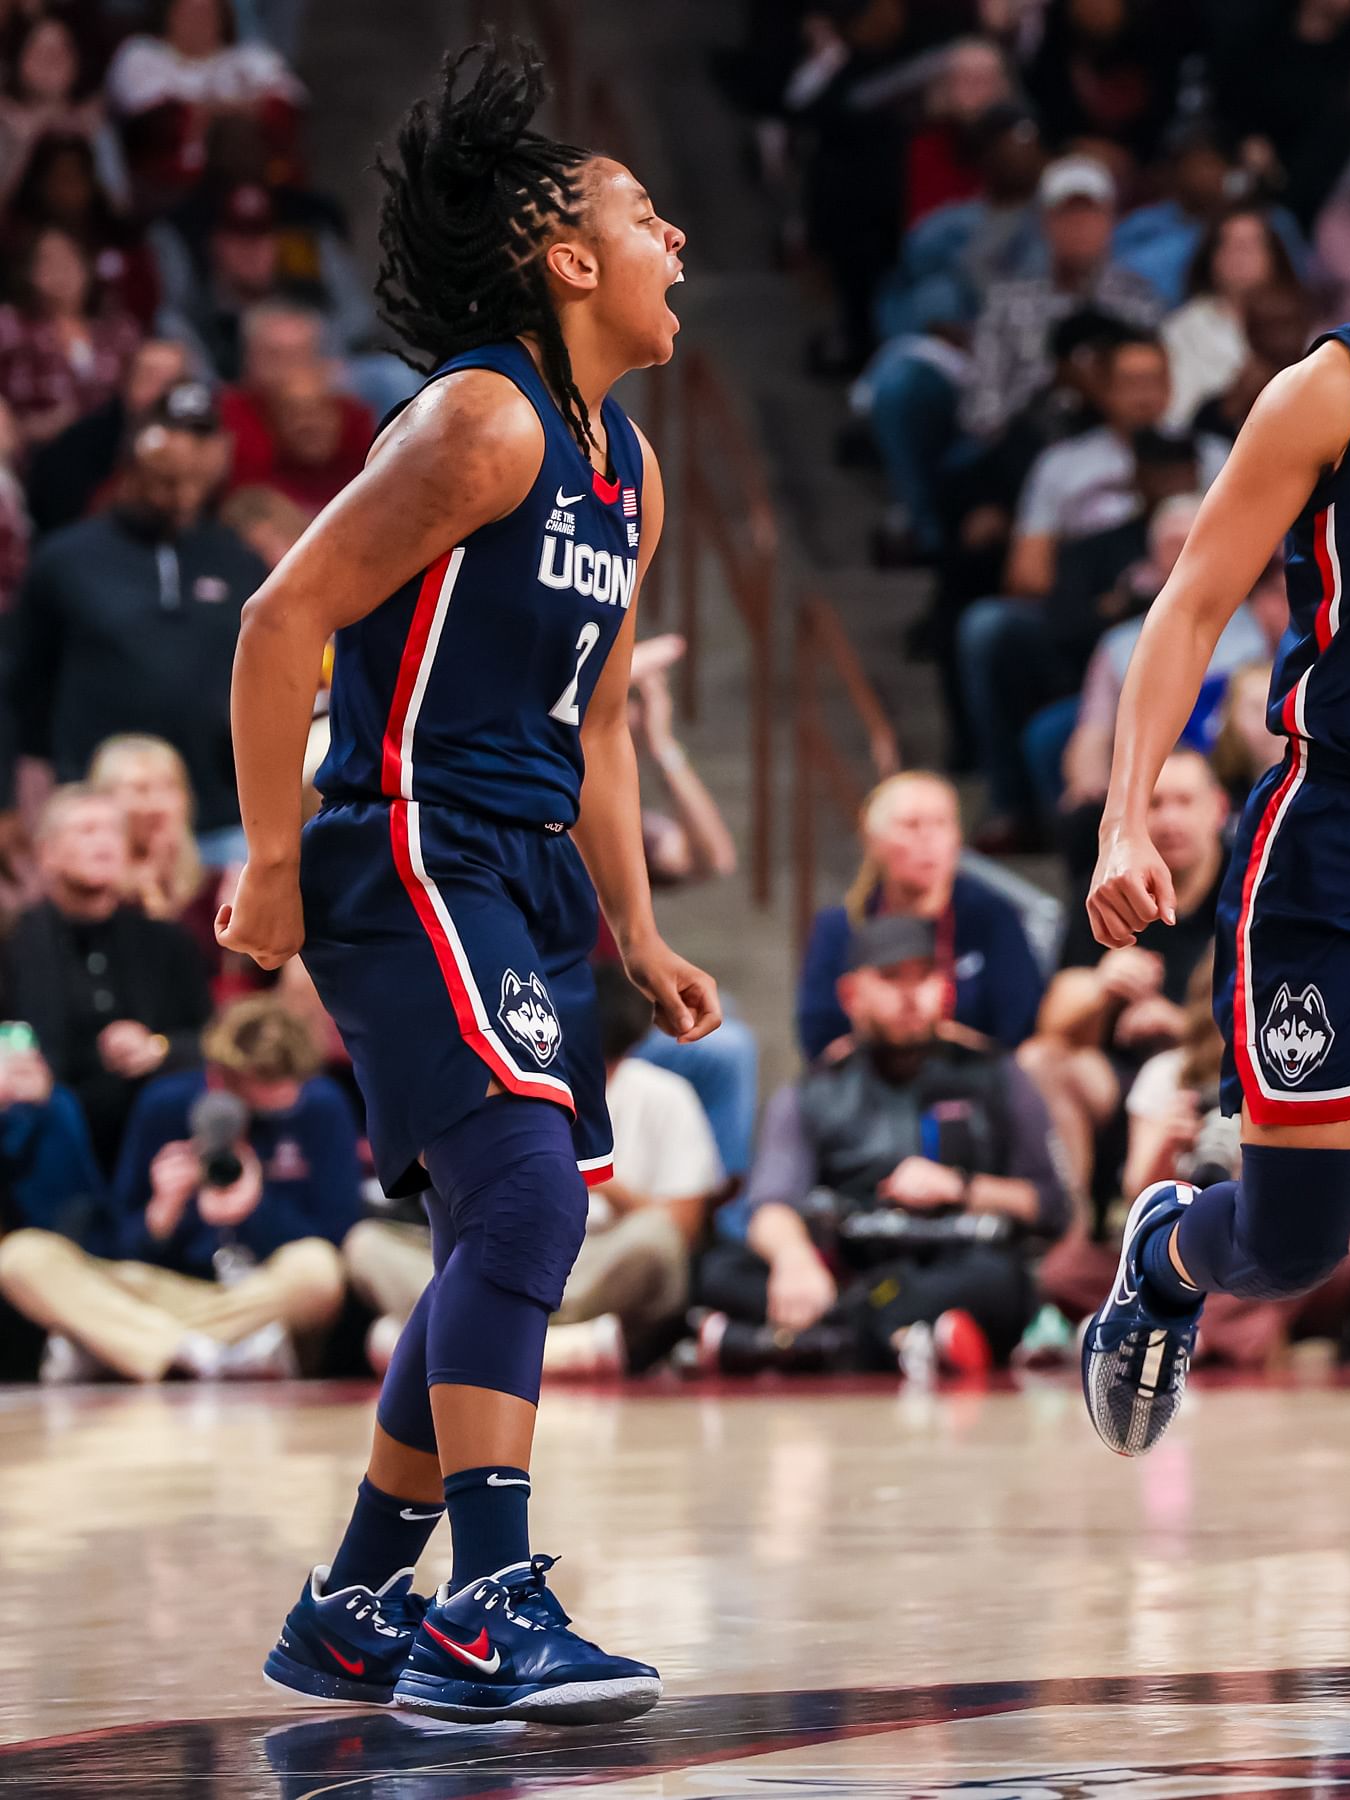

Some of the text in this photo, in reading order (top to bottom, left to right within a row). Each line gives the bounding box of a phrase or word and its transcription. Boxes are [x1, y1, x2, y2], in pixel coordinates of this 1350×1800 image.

[551, 509, 576, 525] BE THE
[545, 519, 576, 536] CHANGE
[547, 621, 600, 726] 2
